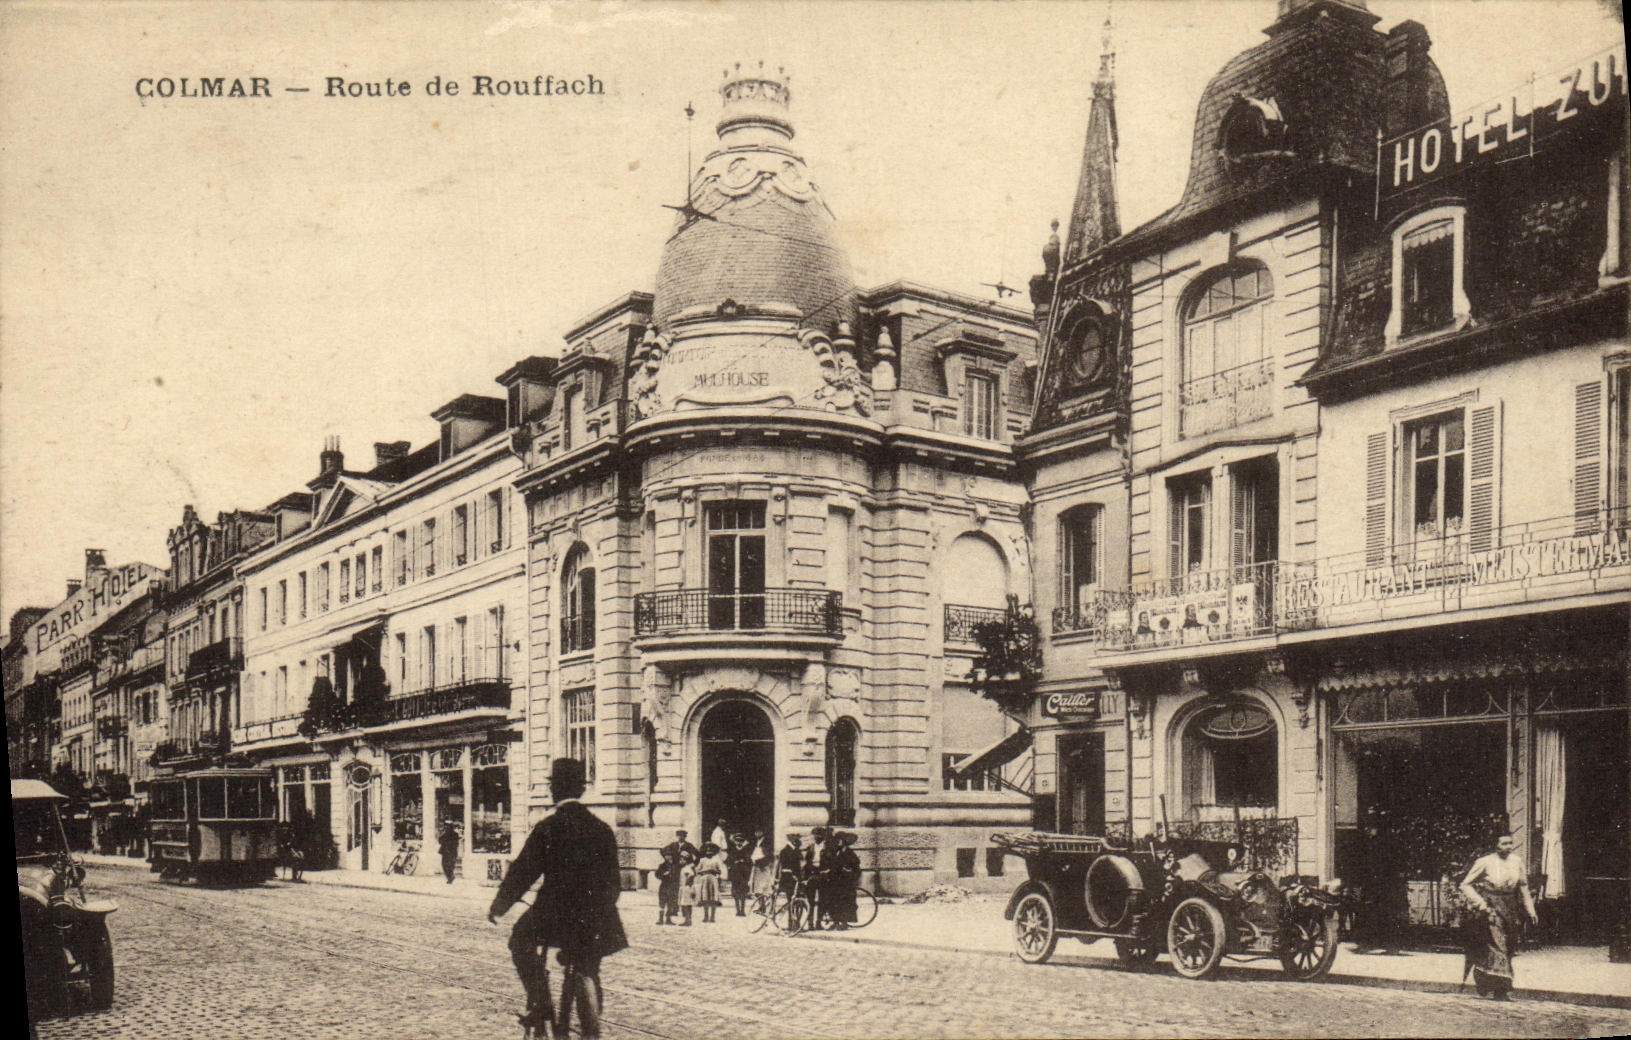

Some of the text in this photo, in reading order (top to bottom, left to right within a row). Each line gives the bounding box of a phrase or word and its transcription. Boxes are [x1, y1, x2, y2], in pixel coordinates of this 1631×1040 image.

[1393, 96, 1528, 187] HOTEL
[693, 371, 769, 389] MULHOUSE
[1279, 560, 1428, 609] RESTAURANT
[1470, 528, 1630, 586] MEISTERMA
[36, 565, 149, 656] PARK HOTEL
